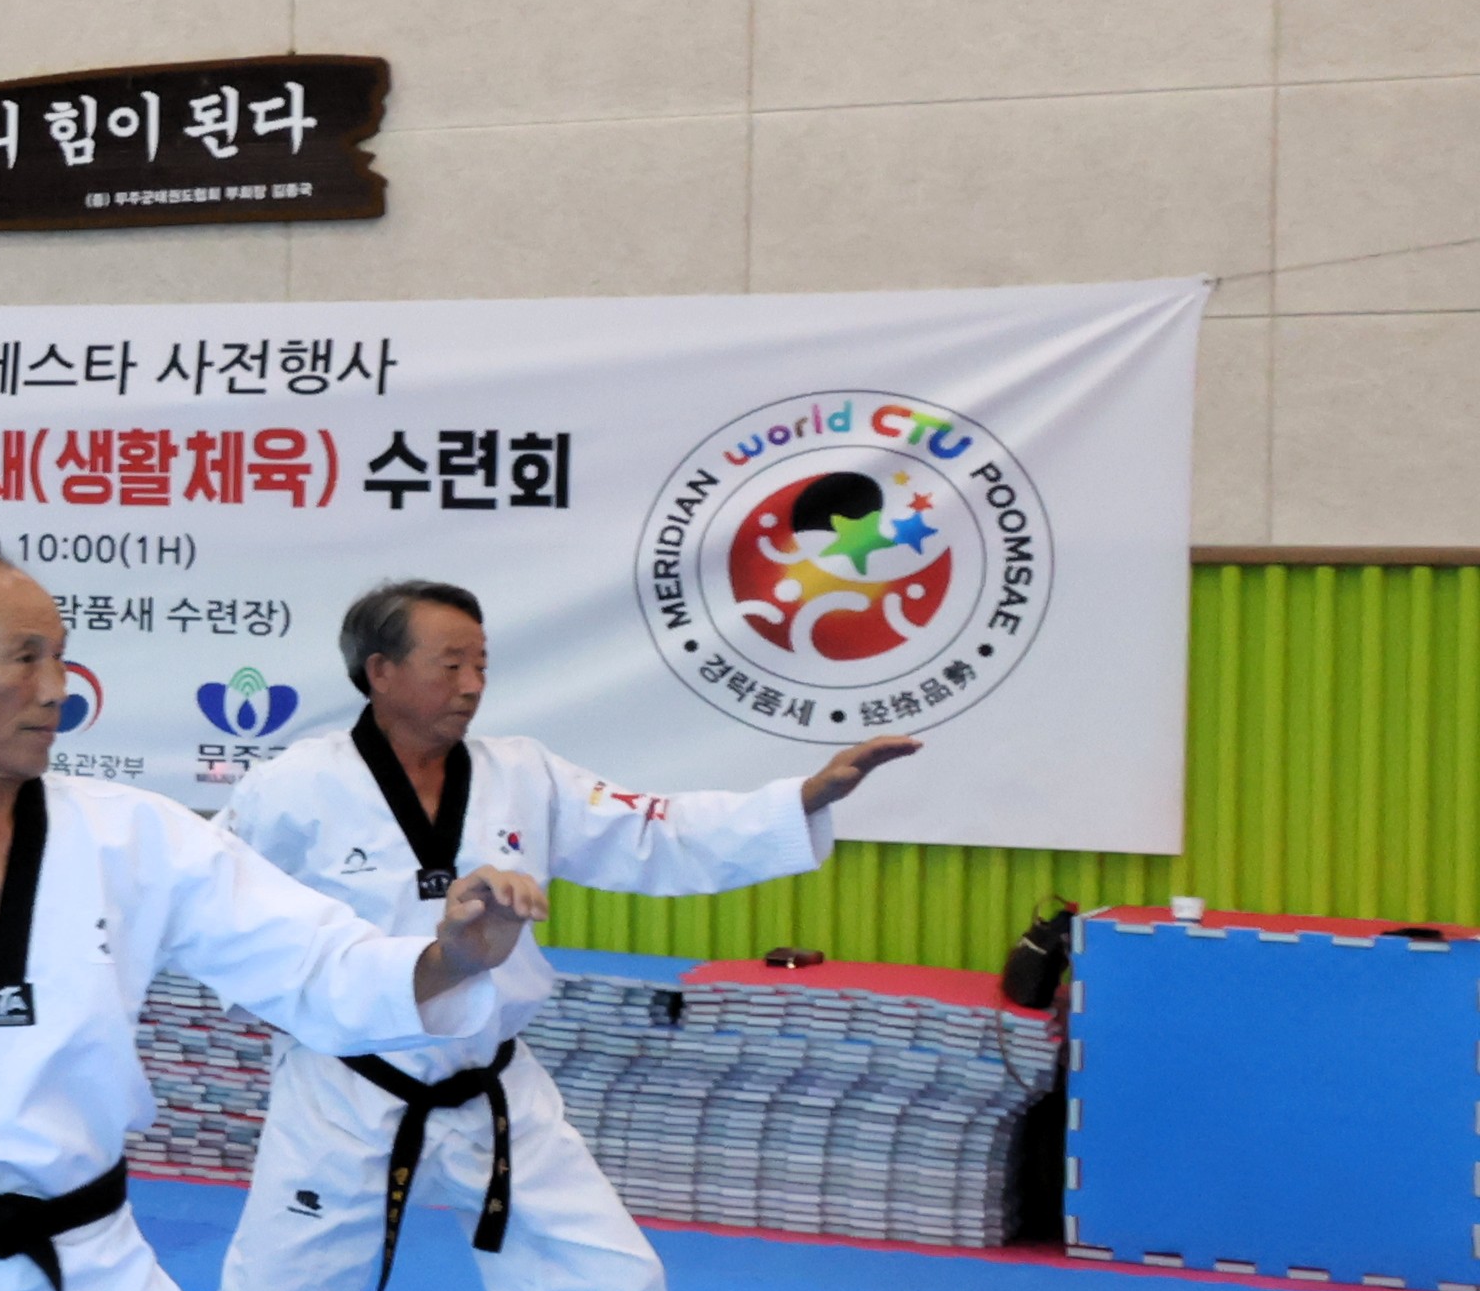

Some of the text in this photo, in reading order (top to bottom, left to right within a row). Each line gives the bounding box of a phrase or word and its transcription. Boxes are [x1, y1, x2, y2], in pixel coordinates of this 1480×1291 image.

[43, 89, 161, 167] 힘이
[184, 81, 318, 161] 된다
[156, 337, 399, 396] 사전행사
[363, 428, 572, 510] 수련회
[723, 399, 973, 466] world CTU
[18, 532, 197, 570] 10:00(1H)
[654, 467, 721, 630] MERIDIAN
[969, 460, 1033, 636] POOMSAE
[166, 598, 292, 637] 수련장)
